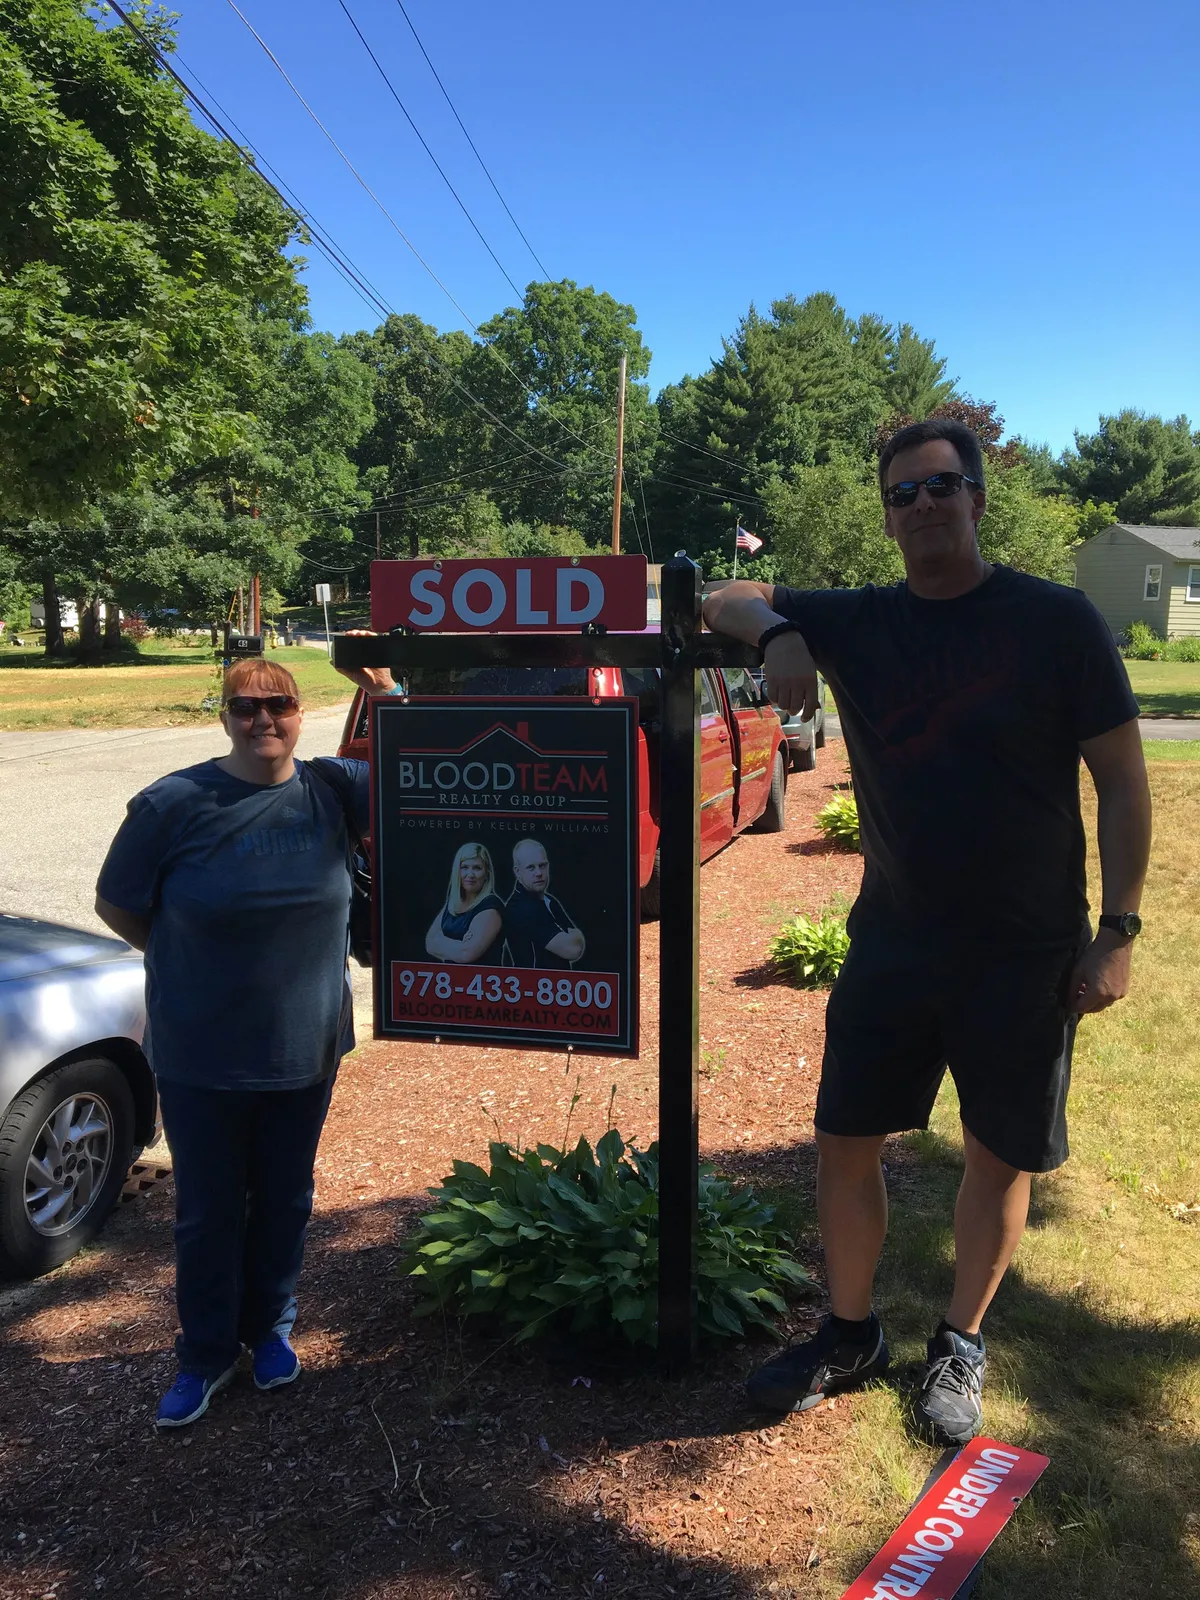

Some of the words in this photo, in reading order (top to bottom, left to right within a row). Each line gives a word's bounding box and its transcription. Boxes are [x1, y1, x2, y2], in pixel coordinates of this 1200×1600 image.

[408, 567, 605, 627] SOLD
[439, 793, 502, 806] REALTY
[510, 795, 567, 807] GROUP
[400, 819, 461, 830] POWERED
[468, 820, 482, 830] BY
[490, 821, 536, 832] KELLER
[545, 823, 609, 834] WILLIAMS
[399, 970, 612, 1009] 978-433-8800
[399, 1001, 612, 1029] BLOODTEAMREALTY.COM
[937, 1448, 1021, 1519] UNDER
